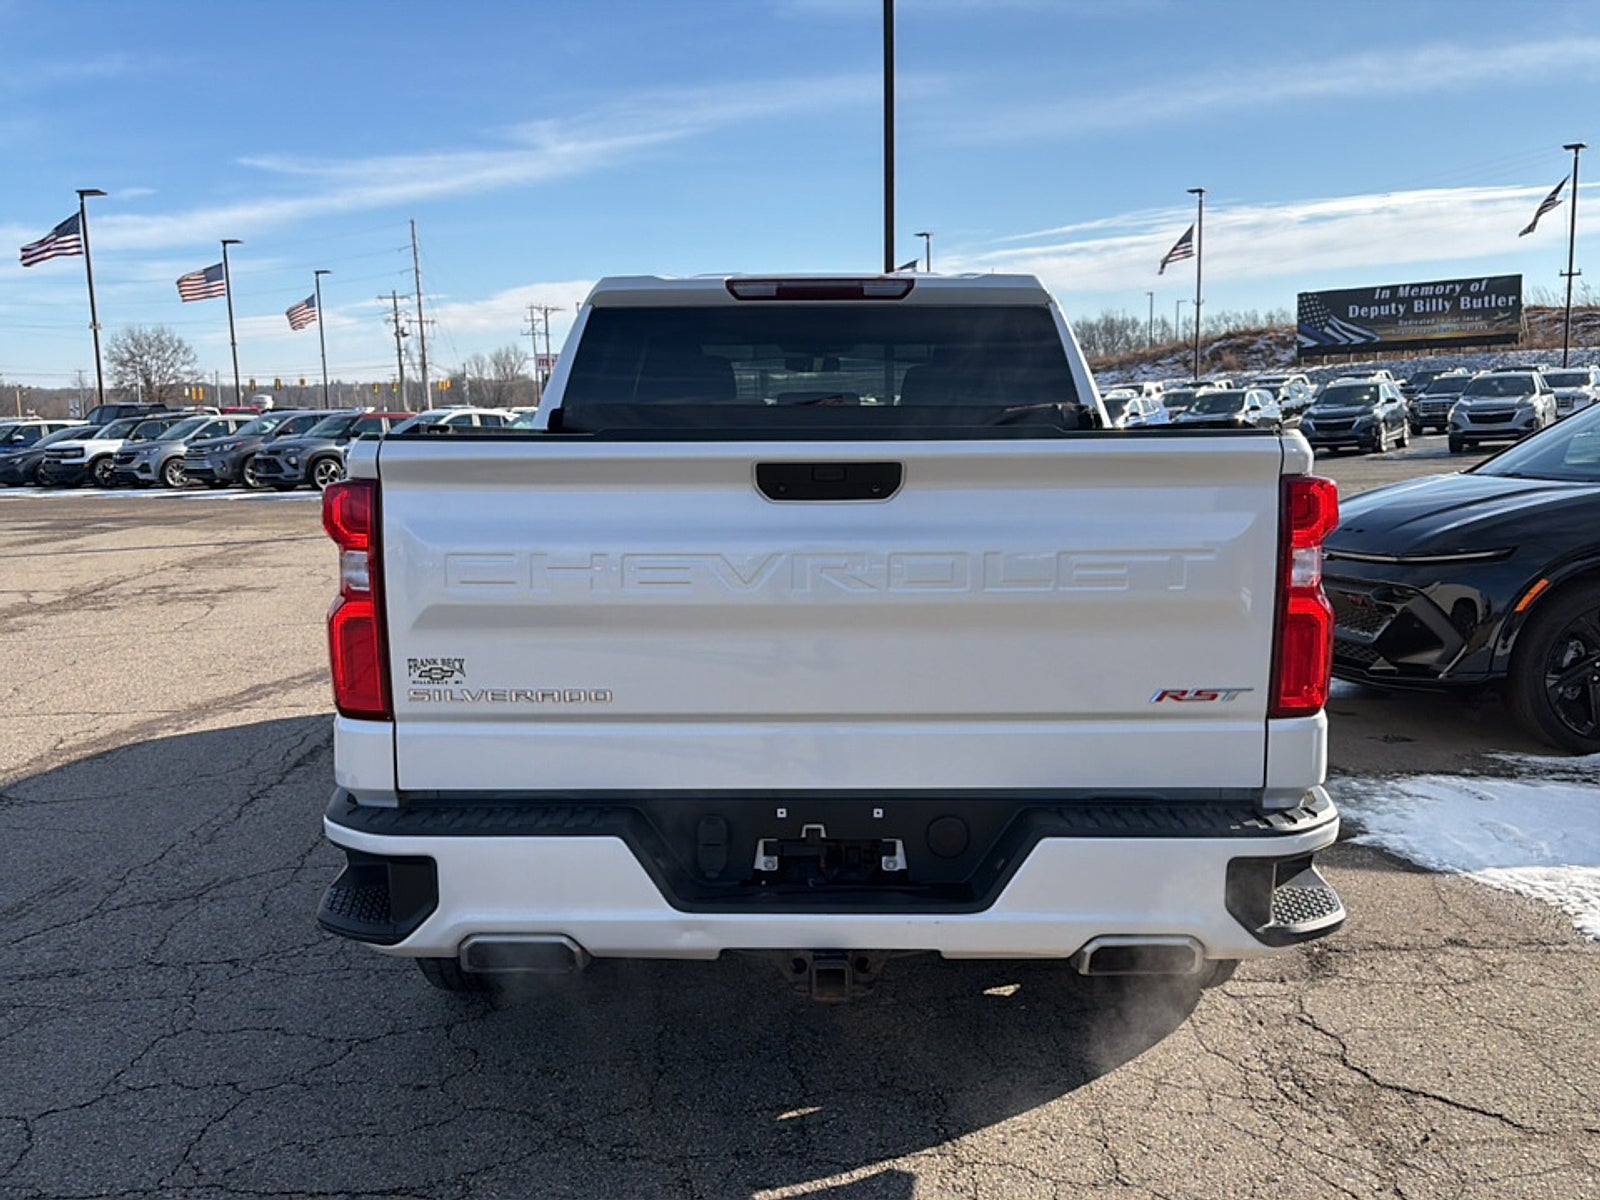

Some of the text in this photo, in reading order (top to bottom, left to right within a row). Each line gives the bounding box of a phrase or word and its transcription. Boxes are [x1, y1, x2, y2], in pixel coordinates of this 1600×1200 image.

[1374, 279, 1488, 299] In Memory of
[1349, 294, 1517, 318] Deputy Billy Butler
[444, 548, 1217, 595] CHEVROLET
[407, 658, 466, 677] FRANK BECK
[407, 688, 613, 703] SILVERADO
[1149, 688, 1254, 703] RST
